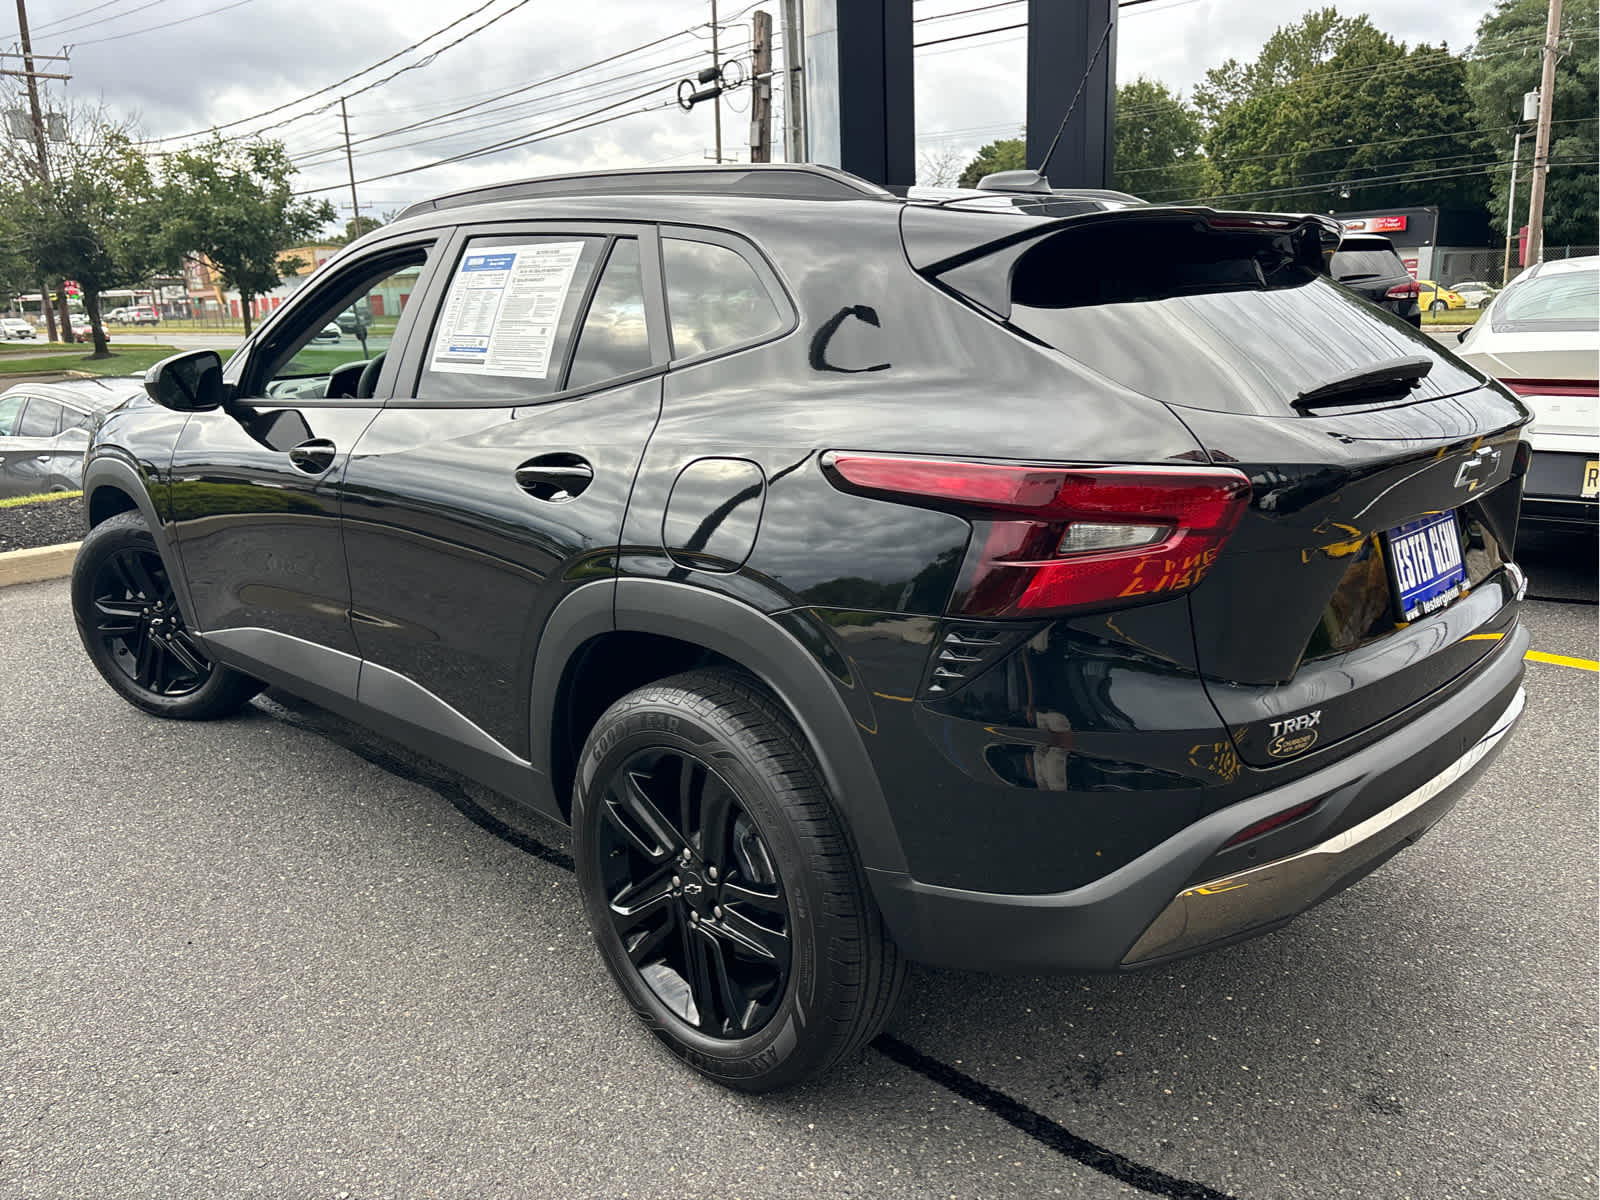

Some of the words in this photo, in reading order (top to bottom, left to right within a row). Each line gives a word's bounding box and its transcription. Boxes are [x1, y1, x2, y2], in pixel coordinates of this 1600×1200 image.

[1391, 532, 1434, 593] LESTER
[1428, 519, 1461, 575] GLENN
[1269, 710, 1321, 737] TRAX
